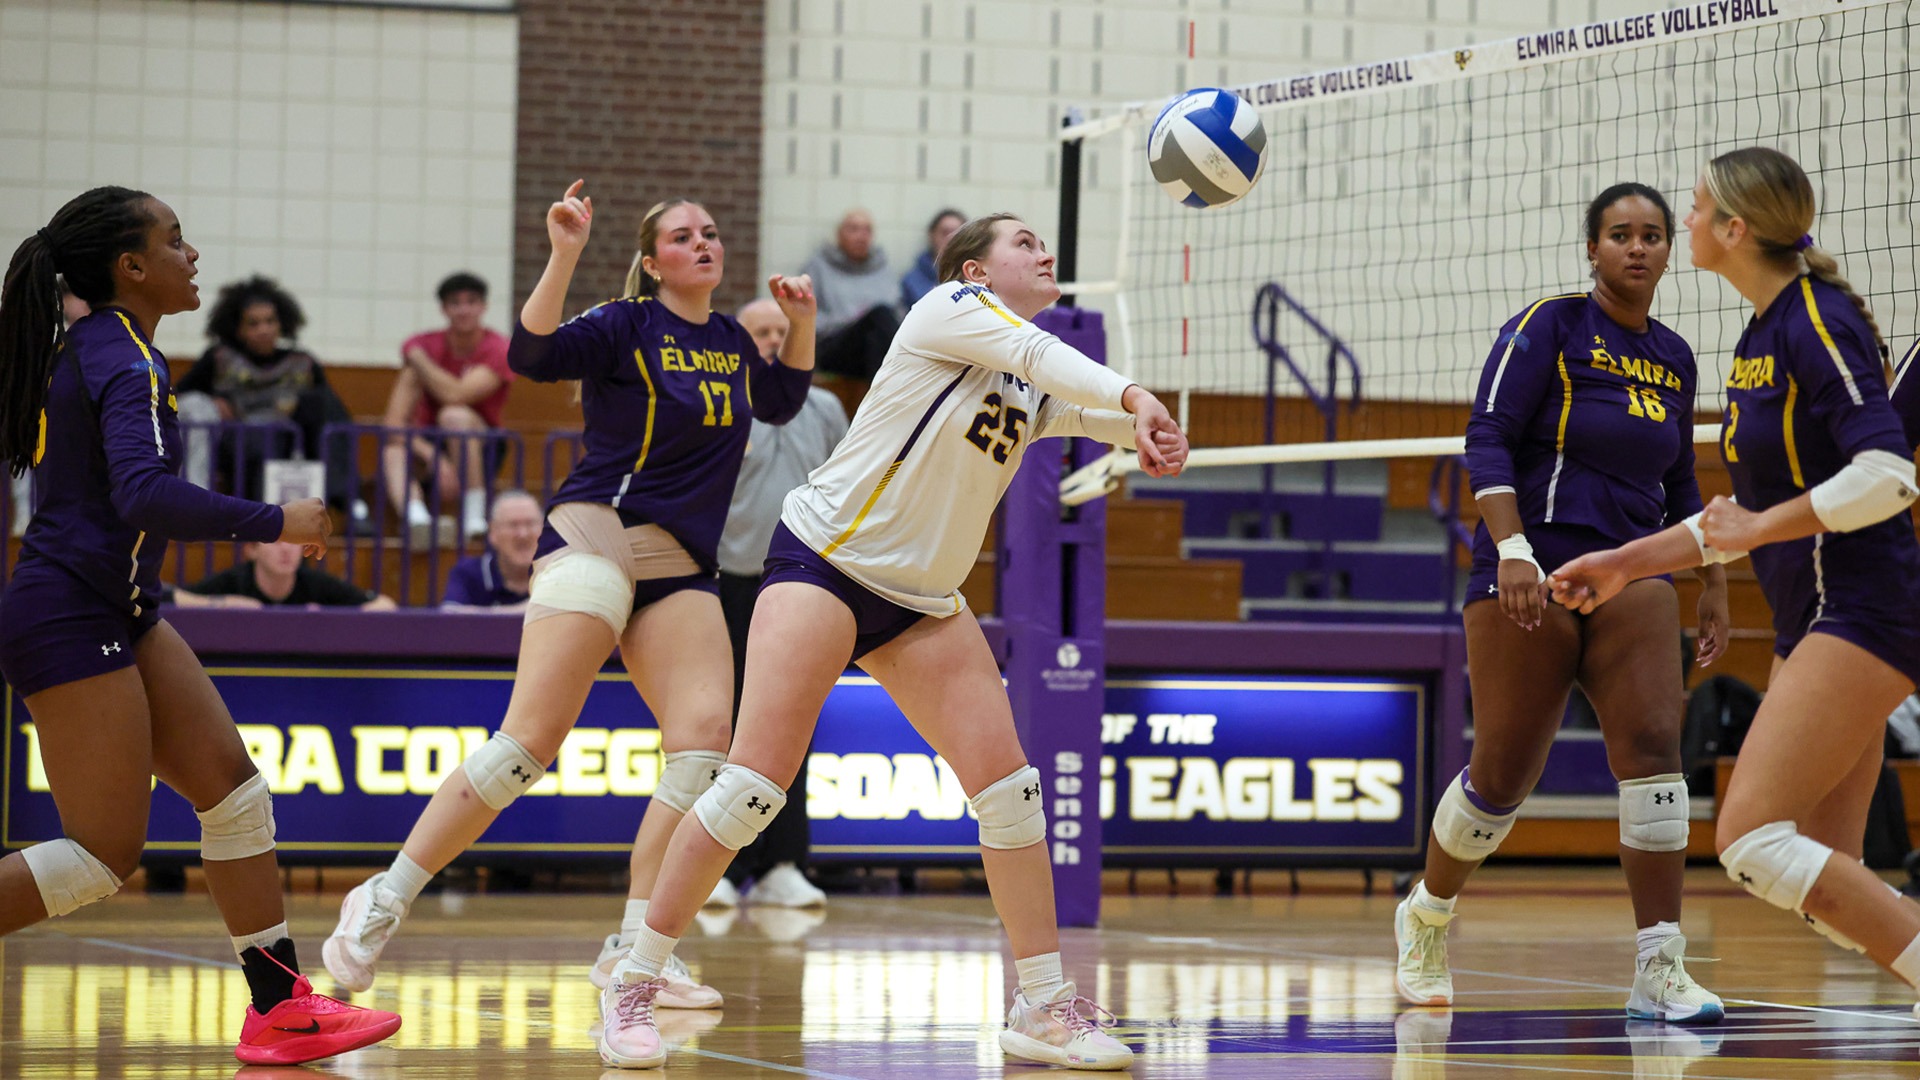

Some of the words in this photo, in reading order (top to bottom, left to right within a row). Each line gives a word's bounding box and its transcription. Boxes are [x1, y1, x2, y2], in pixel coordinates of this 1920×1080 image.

[1517, 28, 1579, 60] ELMIRA
[1583, 14, 1656, 50] COLLEGE
[1661, 0, 1779, 36] VOLLEYBALL
[1257, 76, 1315, 106] COLLEGE
[1319, 60, 1413, 95] VOLLEYBALL
[698, 380, 734, 427] 17
[964, 392, 1028, 466] 25
[1146, 713, 1218, 746] THE
[1125, 756, 1404, 822] EAGLES
